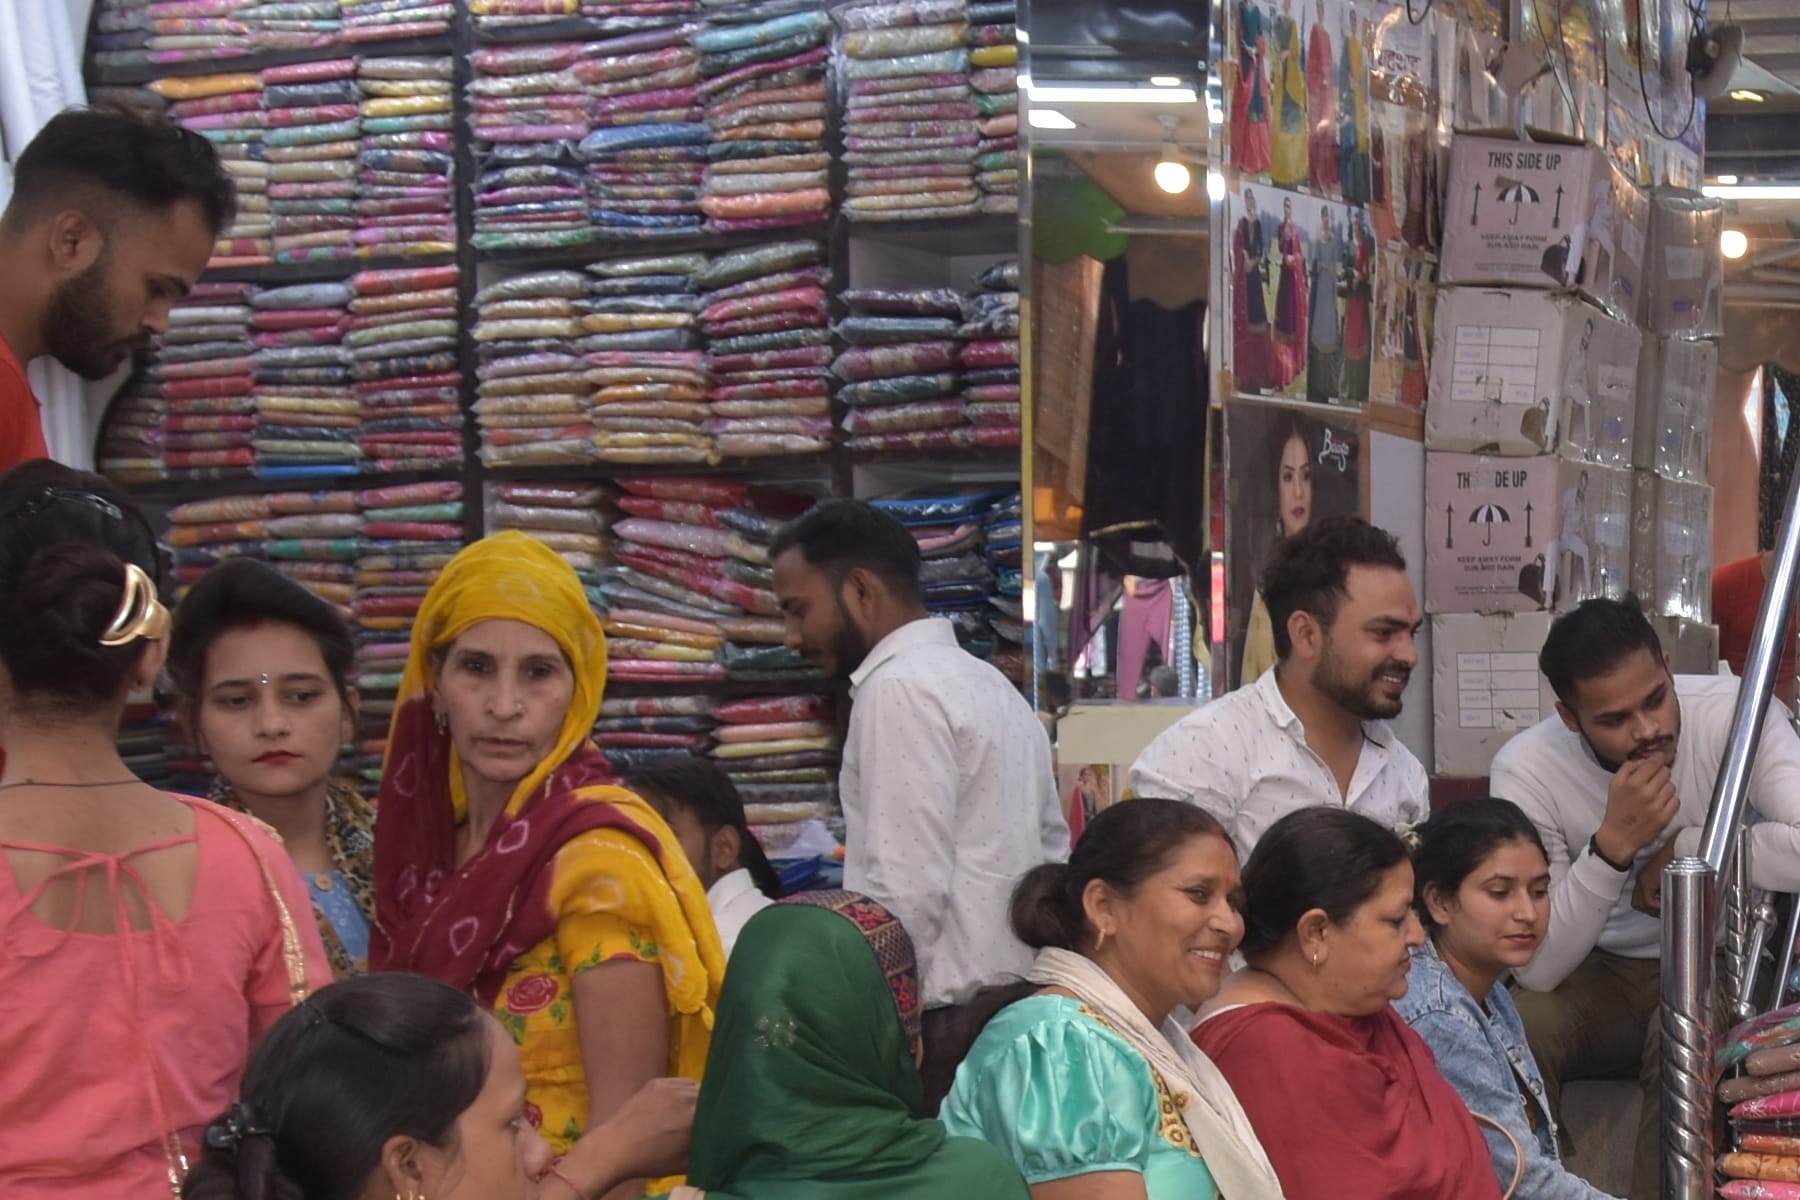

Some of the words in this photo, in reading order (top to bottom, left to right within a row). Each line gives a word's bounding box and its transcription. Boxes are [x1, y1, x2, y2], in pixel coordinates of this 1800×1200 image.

[1488, 151, 1513, 169] THIS
[1516, 152, 1542, 170] SIDE
[1546, 154, 1561, 171] UP
[1457, 472, 1475, 489] TH
[1490, 471, 1509, 488] DE
[1512, 470, 1528, 487] UP
